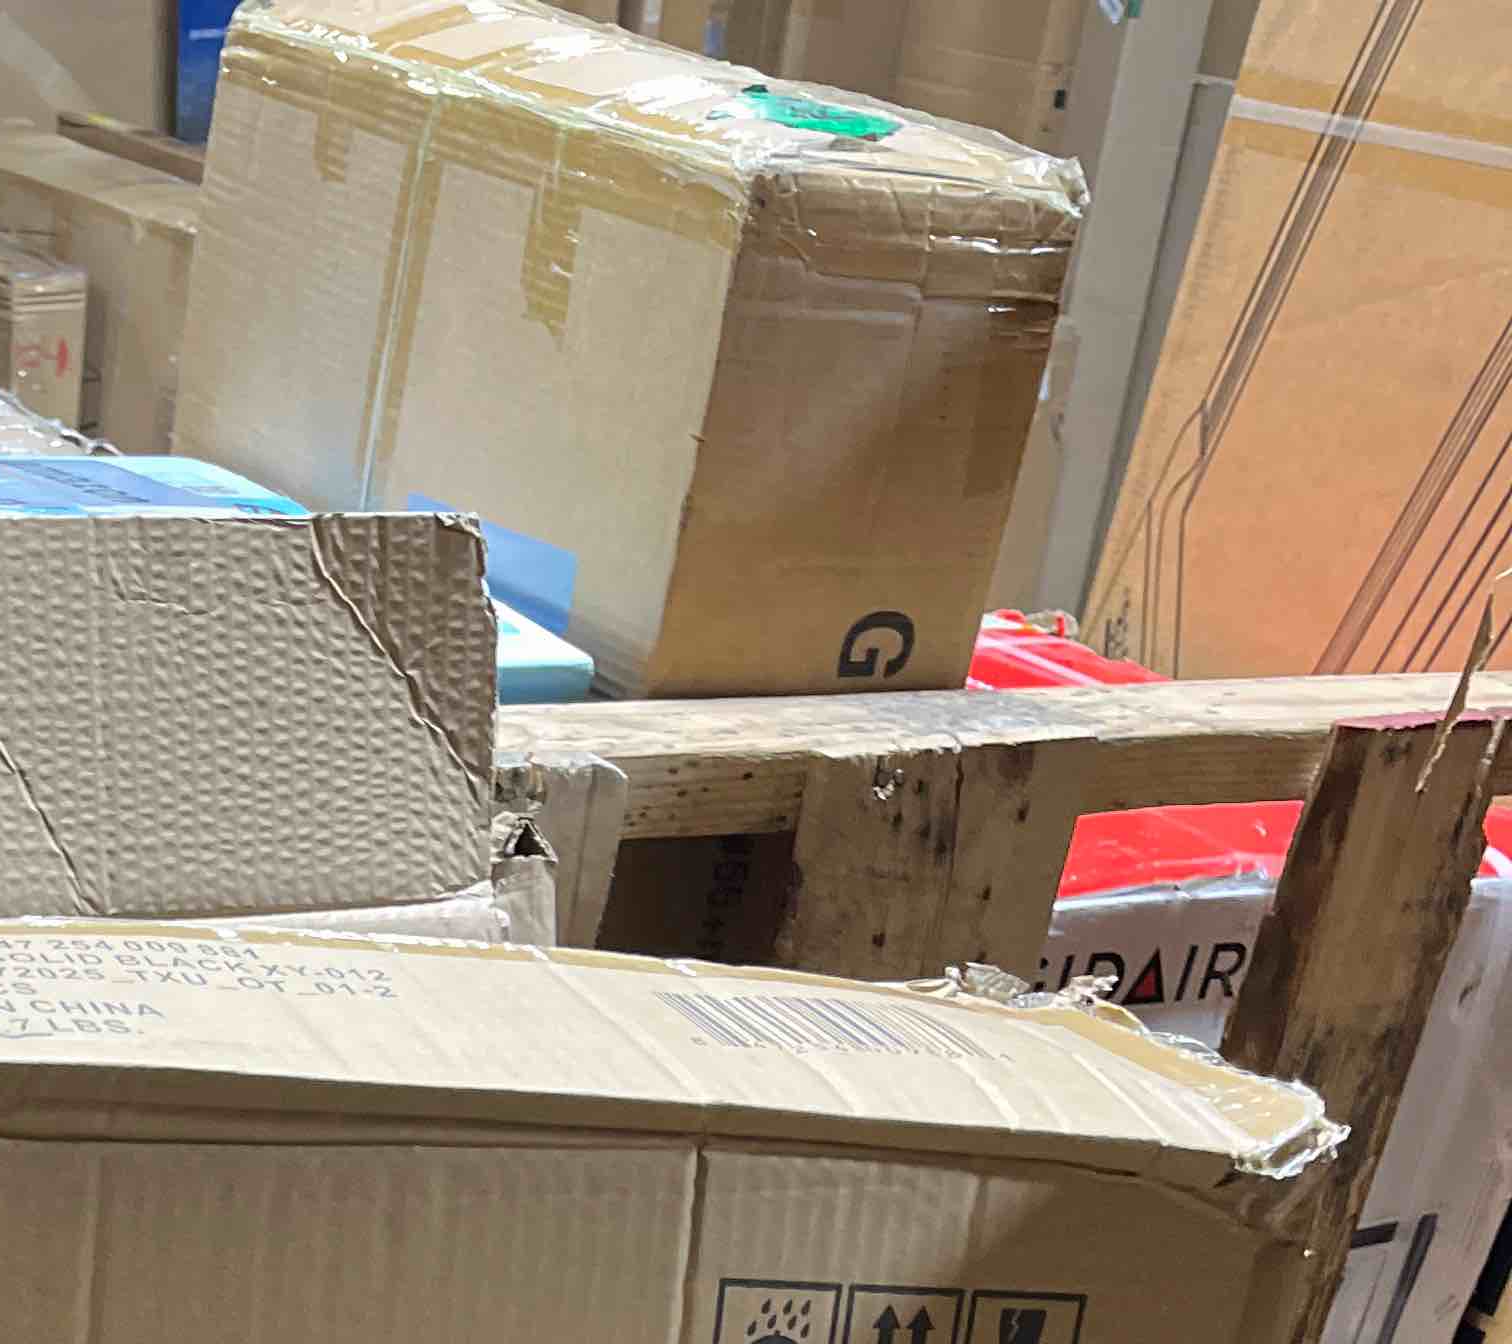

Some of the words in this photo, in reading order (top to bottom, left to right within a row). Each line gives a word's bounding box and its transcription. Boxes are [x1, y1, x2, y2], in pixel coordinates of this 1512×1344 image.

[47, 939, 114, 952] 254
[123, 939, 188, 954] 009
[197, 942, 261, 961] 881
[115, 953, 251, 974] BLACK
[29, 999, 166, 1019] CHINA
